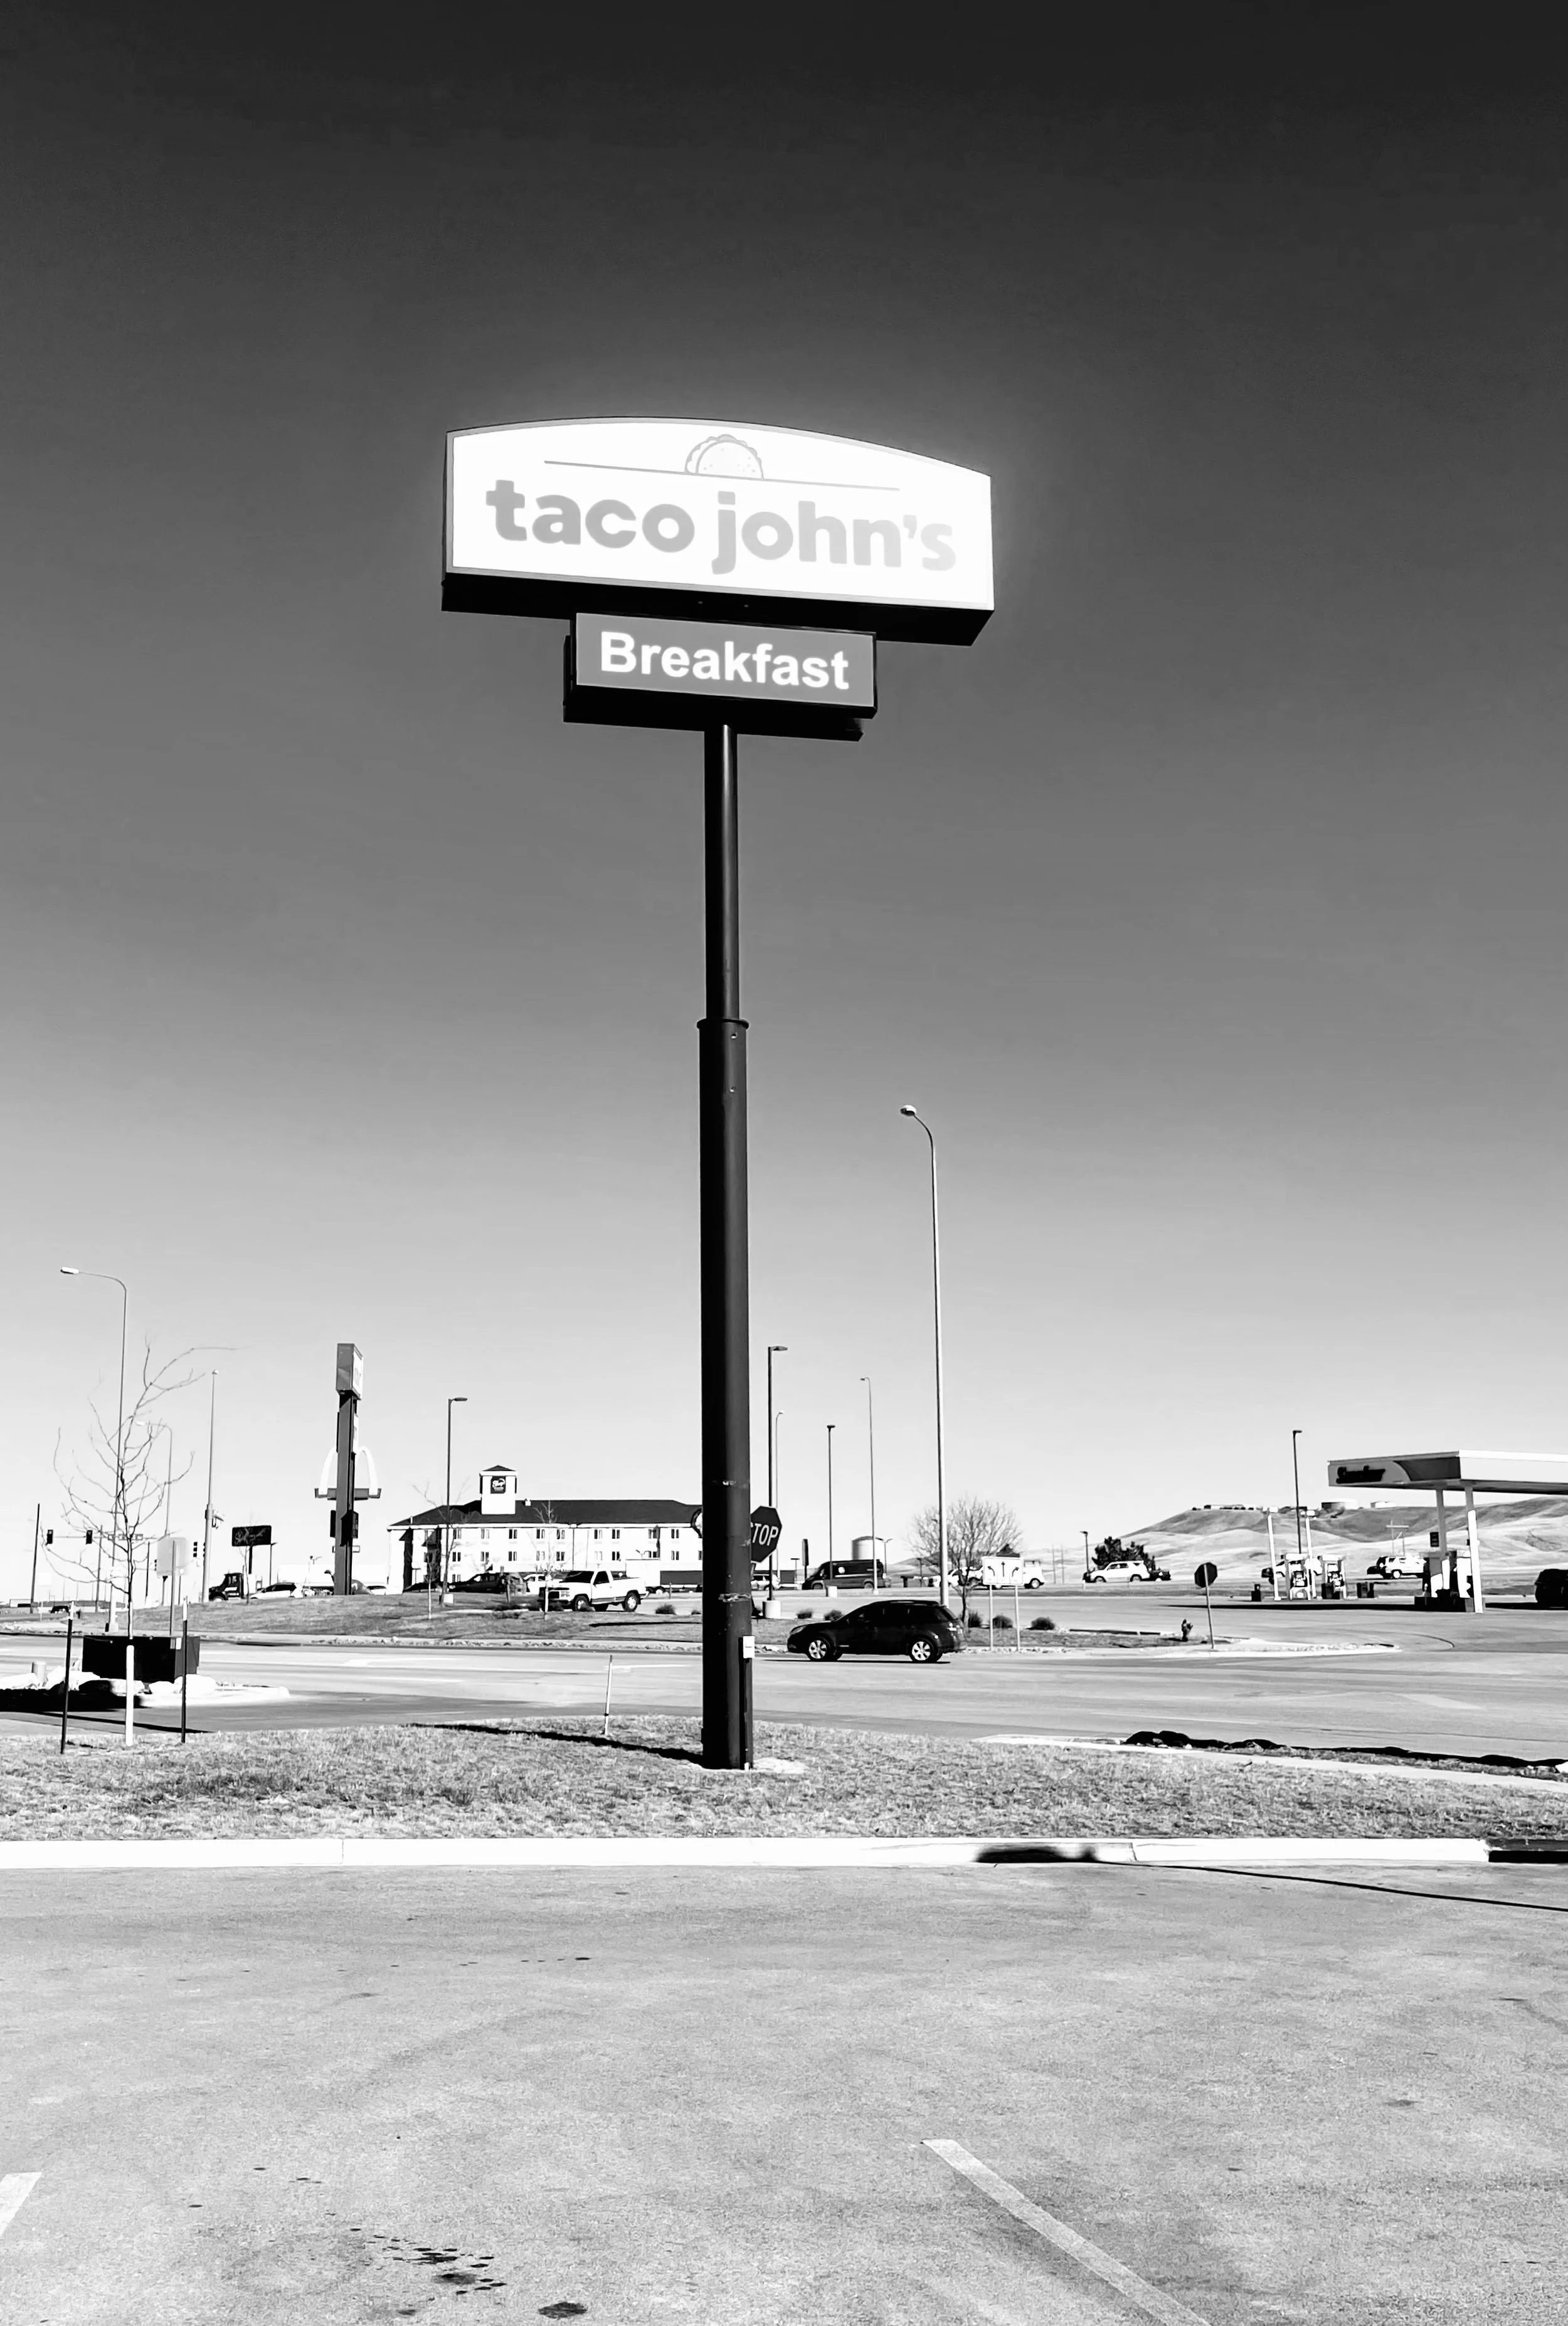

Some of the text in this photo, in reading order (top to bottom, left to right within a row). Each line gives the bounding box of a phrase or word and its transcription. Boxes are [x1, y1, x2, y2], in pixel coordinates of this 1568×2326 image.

[485, 479, 956, 575] taco john's
[600, 630, 850, 691] Breakfast
[750, 1521, 779, 1546] TOP
